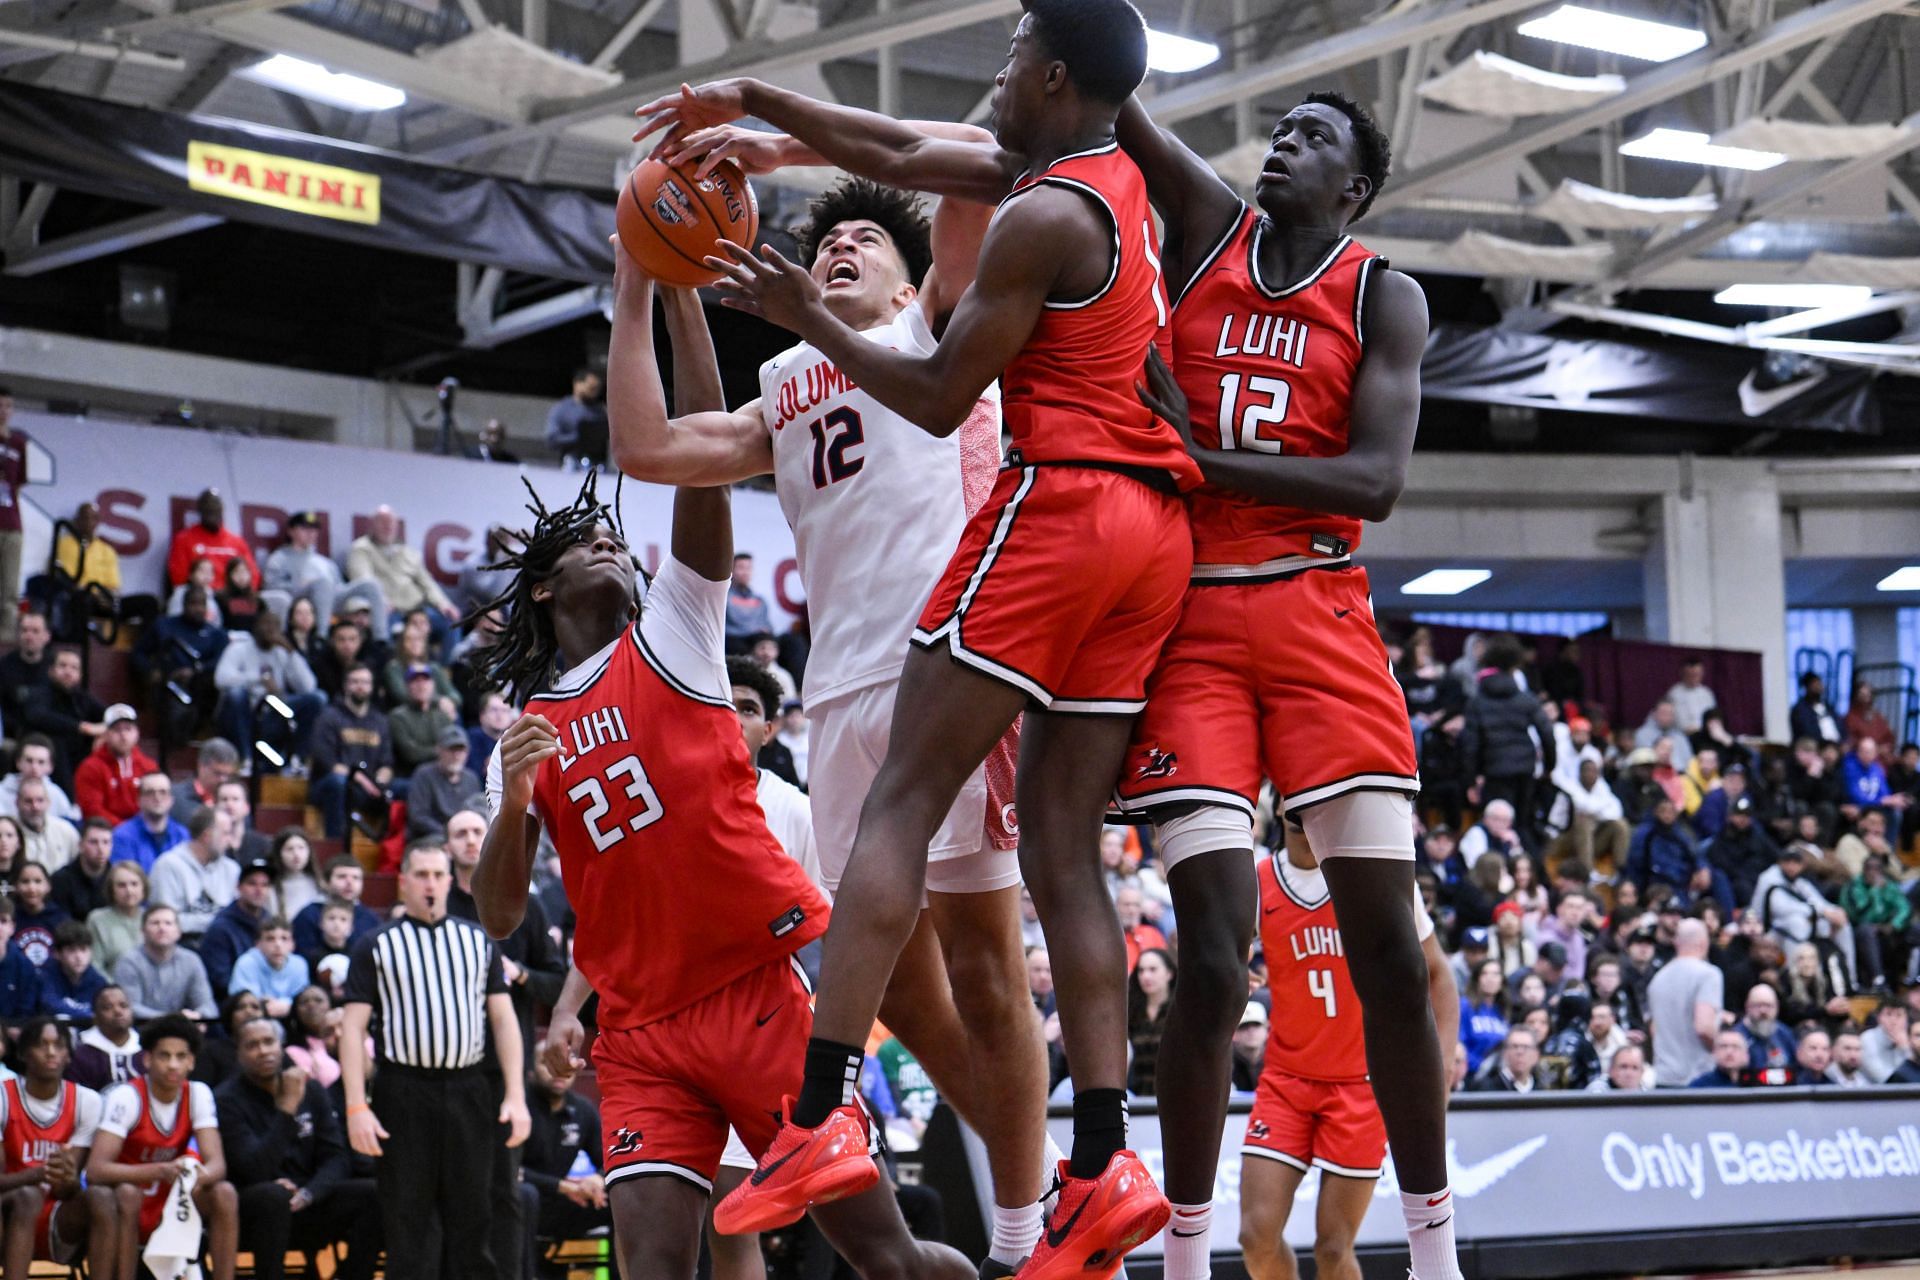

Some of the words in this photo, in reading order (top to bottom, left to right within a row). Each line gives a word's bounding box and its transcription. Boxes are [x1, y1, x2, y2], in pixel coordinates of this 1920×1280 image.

[203, 156, 366, 209] PANINI
[1215, 313, 1309, 368] LUHI
[808, 404, 865, 490] 12
[1219, 373, 1291, 455] 12
[555, 706, 630, 773] LUHI
[567, 754, 665, 853] 23
[1290, 925, 1345, 961] LUHI
[1308, 969, 1337, 1018] 4
[1601, 1131, 1705, 1201] Only
[1707, 1126, 1920, 1185] Basketball
